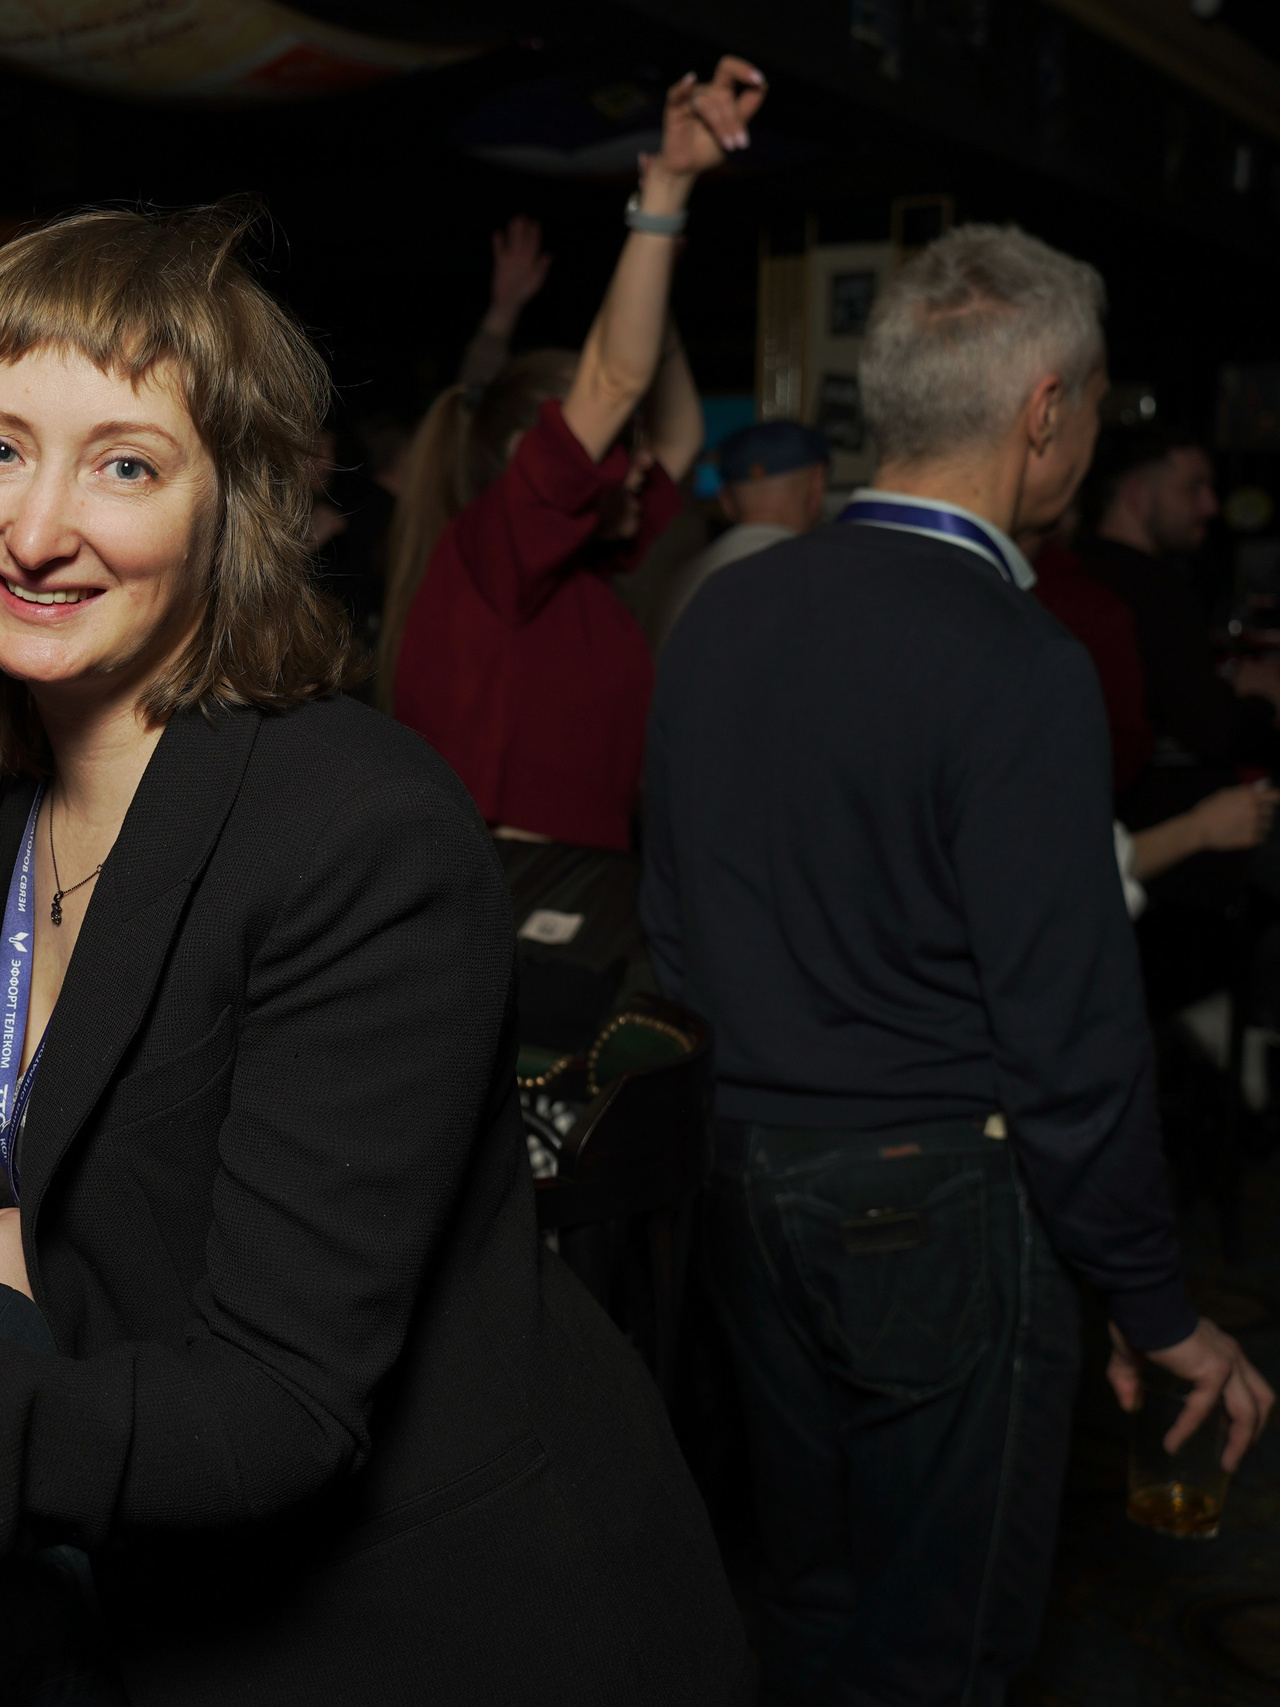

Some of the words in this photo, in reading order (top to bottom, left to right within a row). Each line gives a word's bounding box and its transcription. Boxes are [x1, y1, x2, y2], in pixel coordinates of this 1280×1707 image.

[18, 874, 28, 912] СВЯЗИ
[7, 959, 22, 1010] ЭФФОРТ
[0, 1010, 18, 1069] ТЕЛЕКОМ
